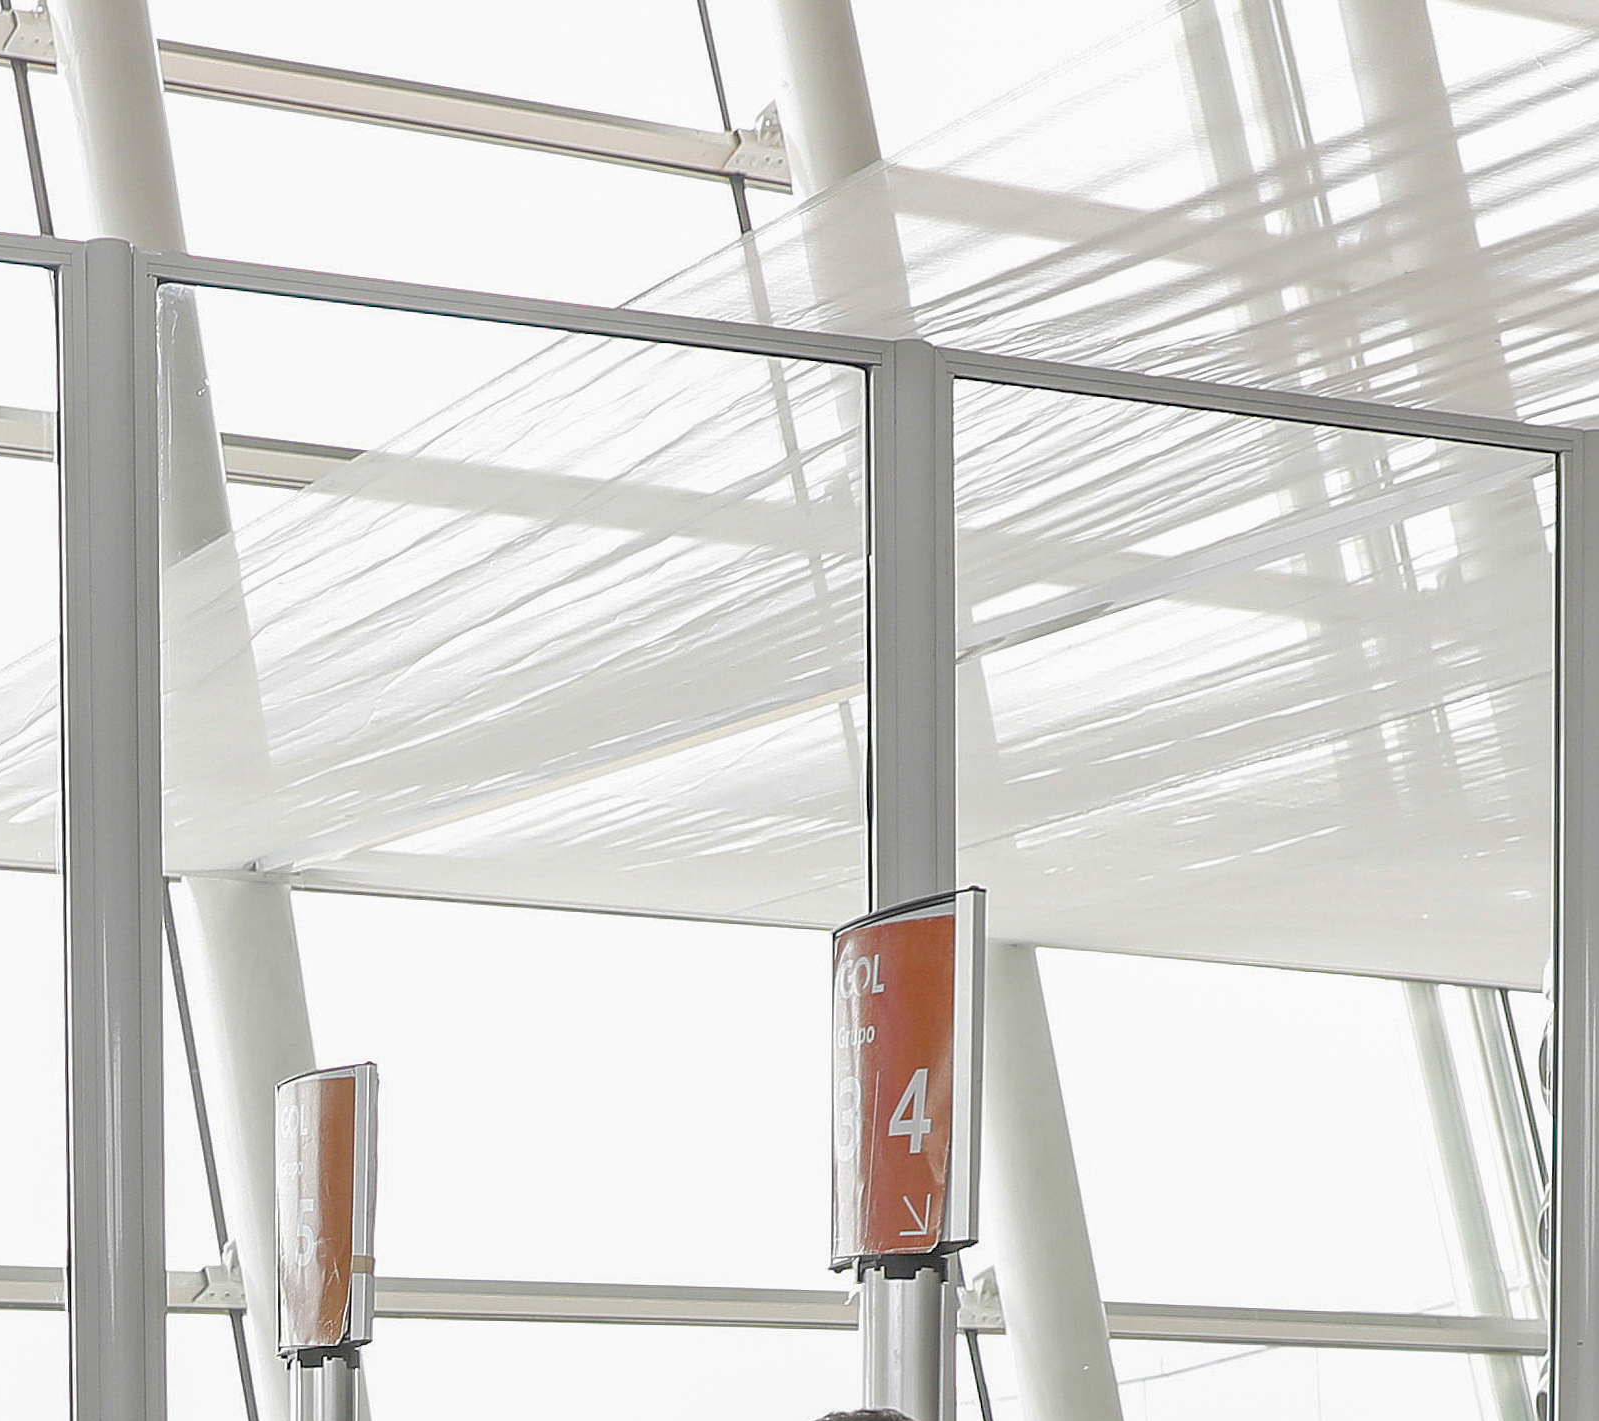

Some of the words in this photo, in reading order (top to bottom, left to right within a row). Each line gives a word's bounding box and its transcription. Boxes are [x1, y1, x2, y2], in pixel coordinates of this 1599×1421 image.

[839, 954, 885, 999] GOL
[837, 1024, 875, 1052] Grupo
[887, 1067, 933, 1154] 4
[296, 1198, 315, 1268] 5
